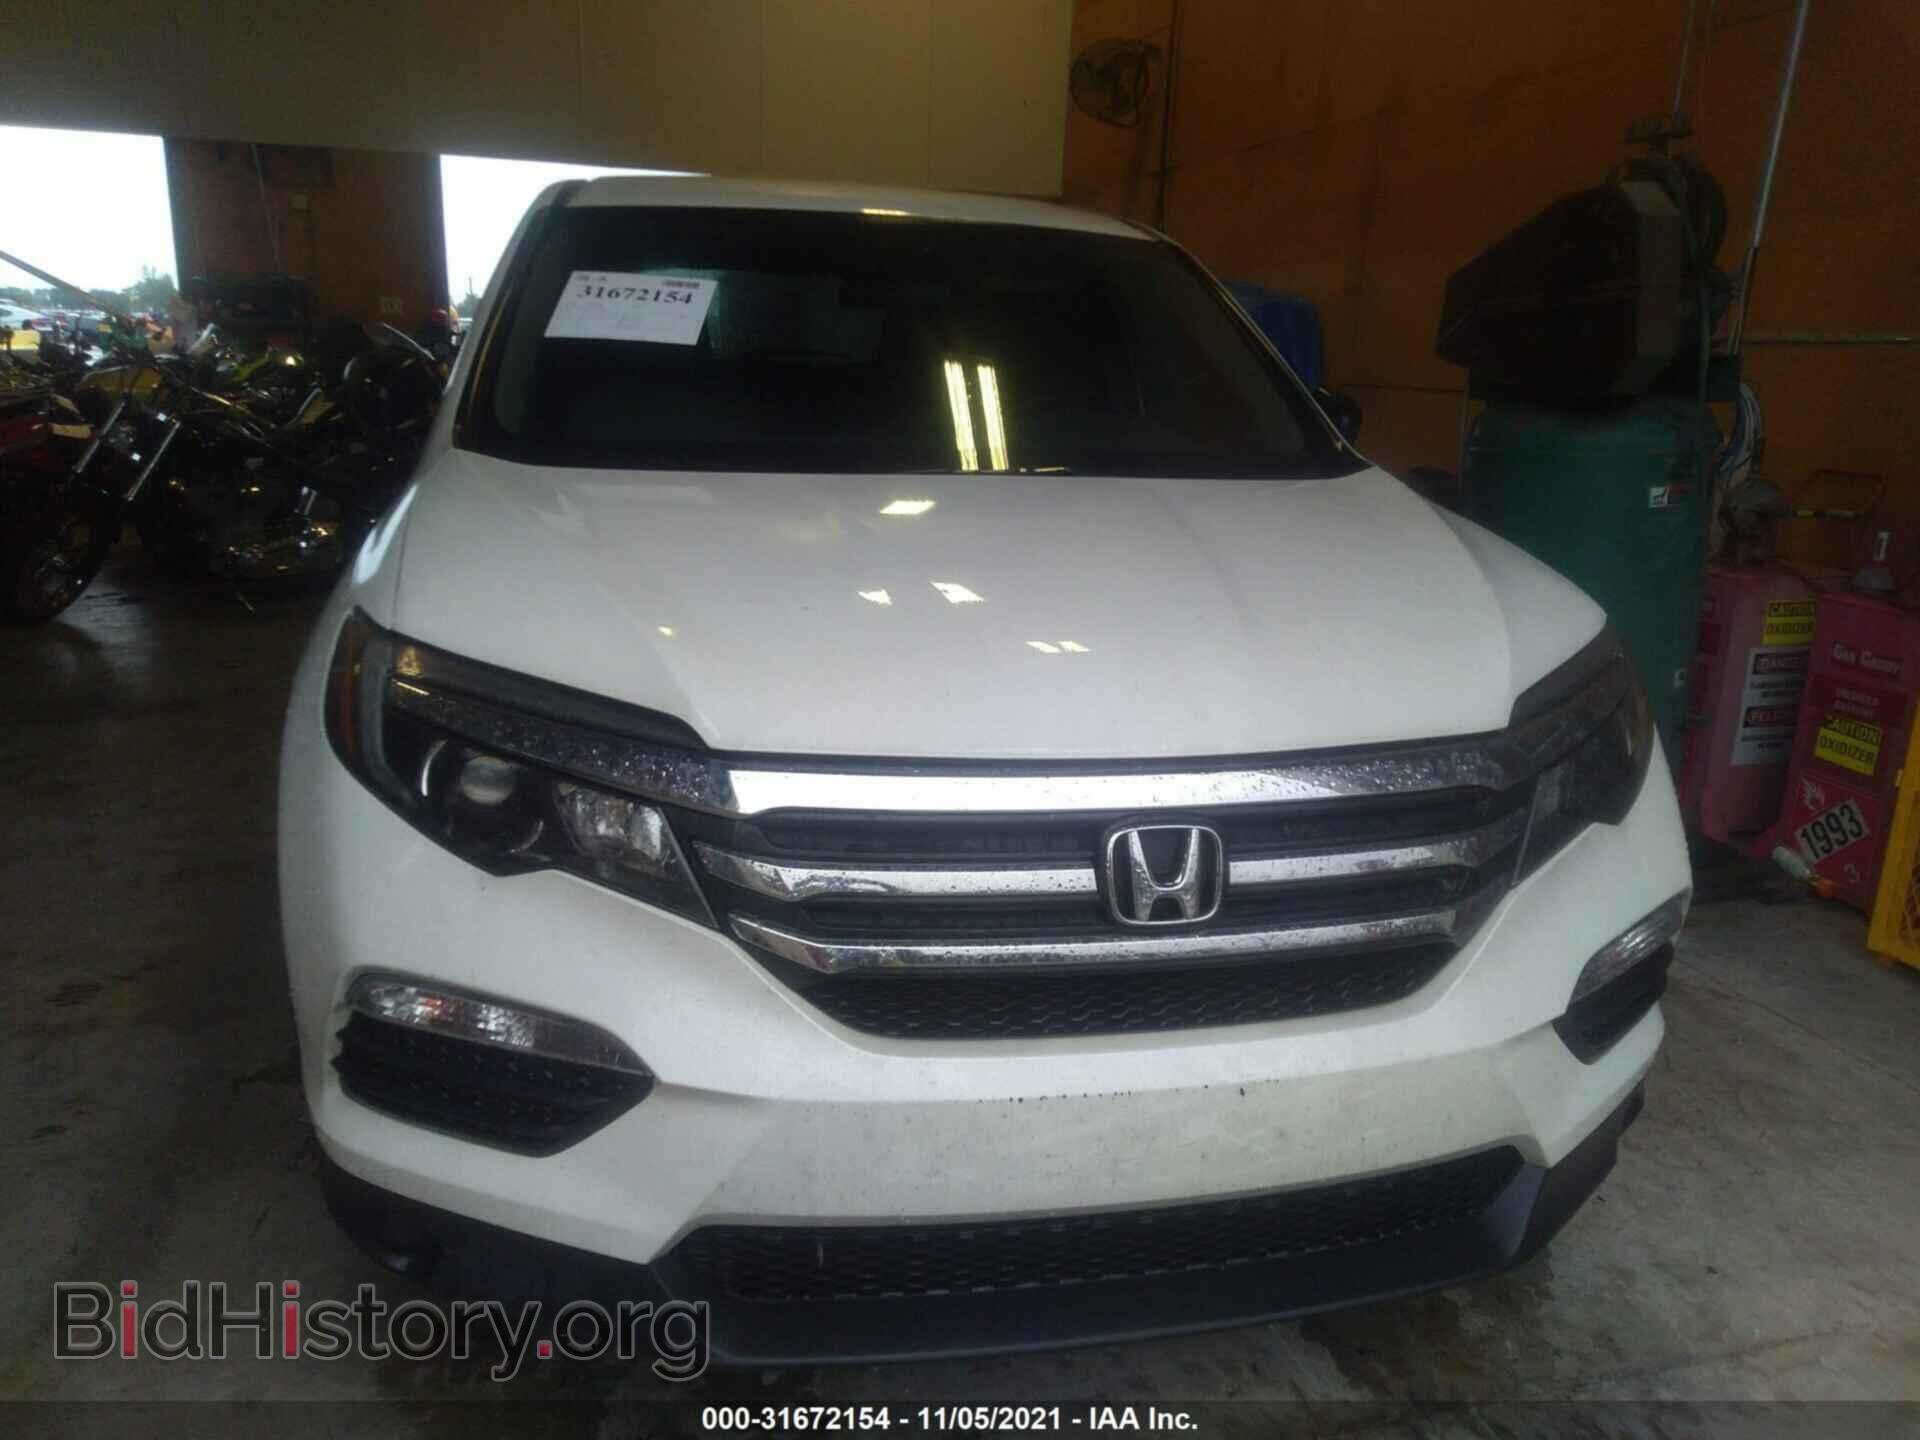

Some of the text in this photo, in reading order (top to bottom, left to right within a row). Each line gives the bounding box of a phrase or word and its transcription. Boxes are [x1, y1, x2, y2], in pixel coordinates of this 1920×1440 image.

[576, 284, 693, 305] 31672154
[1819, 736, 1874, 766] OXIDIZER
[1801, 804, 1863, 859] 1993
[1843, 863, 1860, 883] 3
